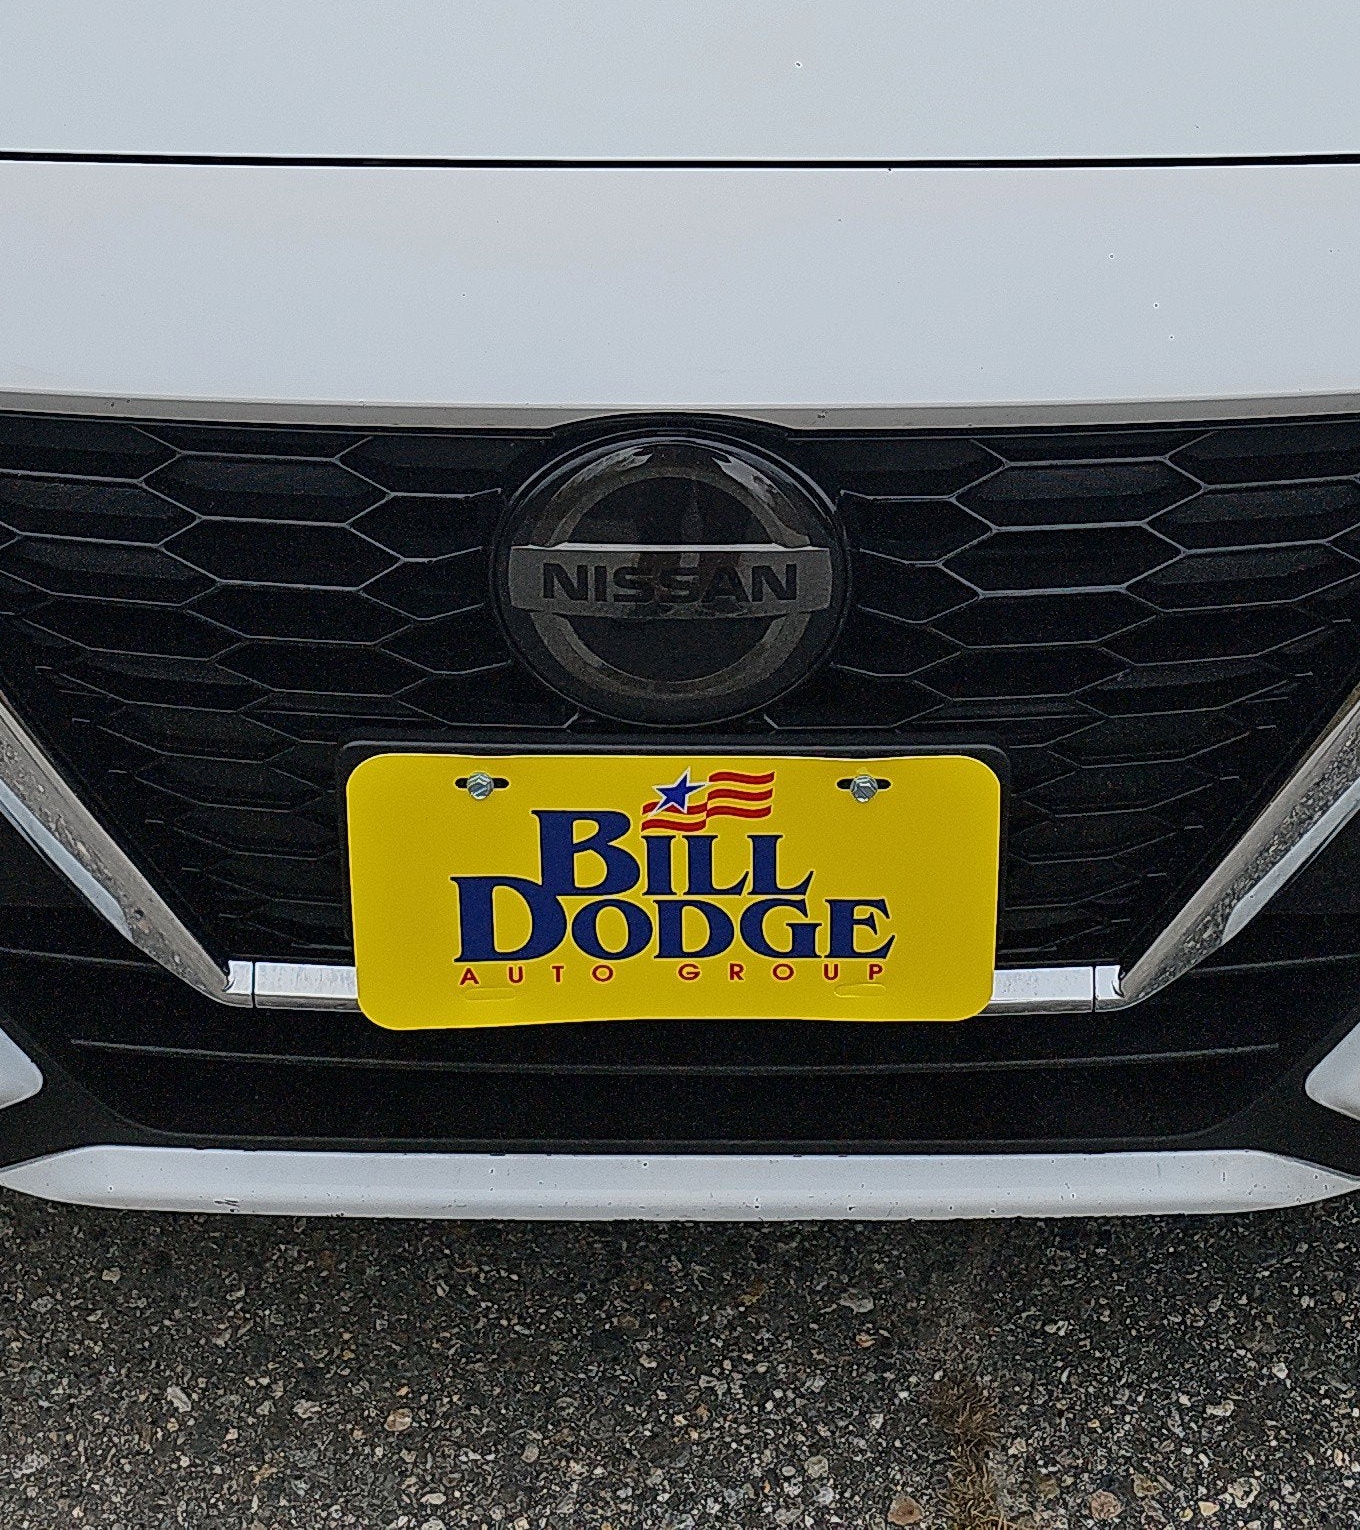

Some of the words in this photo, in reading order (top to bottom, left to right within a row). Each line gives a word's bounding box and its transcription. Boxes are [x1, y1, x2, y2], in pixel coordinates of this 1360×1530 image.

[543, 563, 796, 602] NISSAN
[531, 810, 814, 897] BILL
[450, 876, 896, 963] DODGE
[459, 965, 615, 986] AUTO
[678, 963, 885, 982] GROUP
